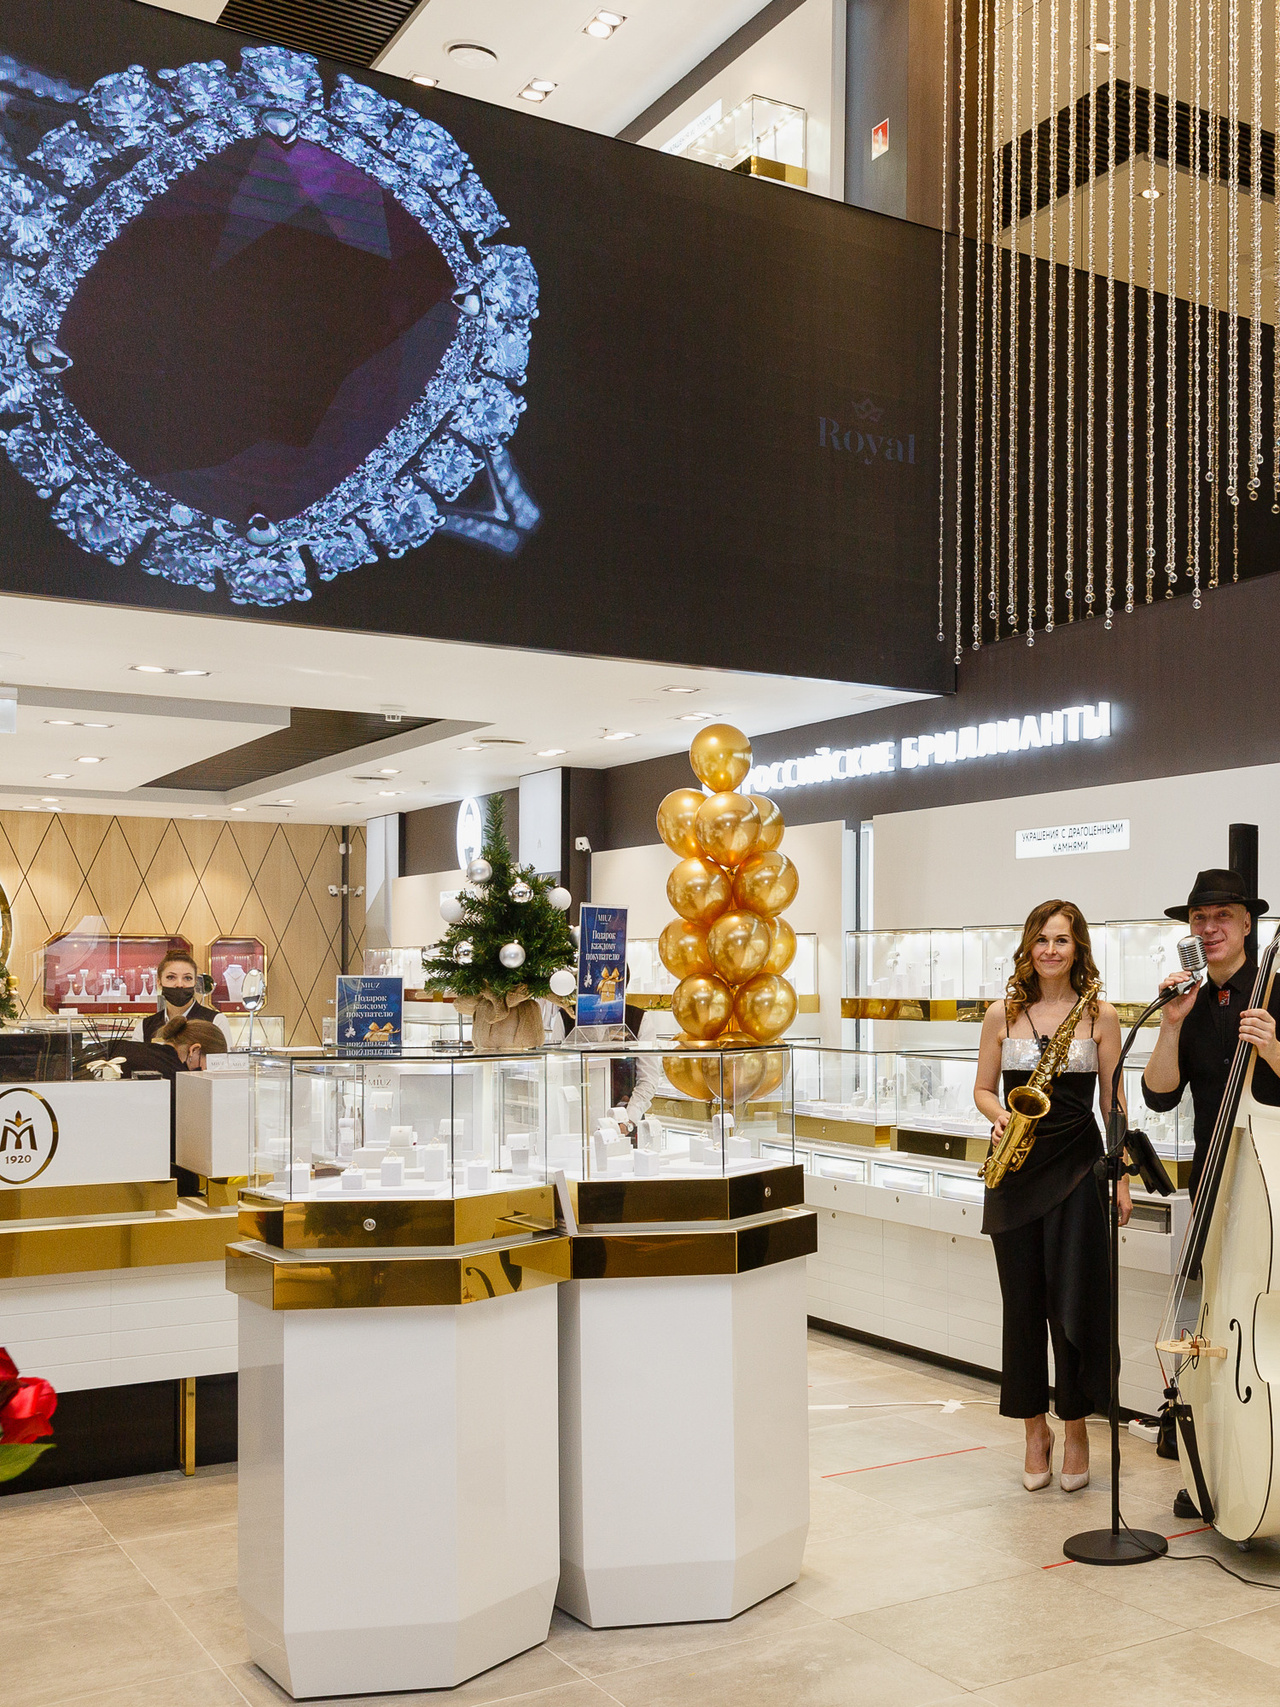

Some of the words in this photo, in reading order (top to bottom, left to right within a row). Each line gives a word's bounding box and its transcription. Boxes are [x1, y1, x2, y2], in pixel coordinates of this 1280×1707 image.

[818, 416, 916, 465] Royal
[1022, 829, 1059, 842] УКРАШЕНИЯ
[1068, 823, 1124, 838] ДРАГОЦЕННЫМИ
[1053, 841, 1089, 853] КАМНЯМИ
[354, 994, 388, 1003] Подарок
[352, 1003, 388, 1011] каждому
[346, 1011, 394, 1019] покупателю
[5, 1154, 32, 1164] 1920
